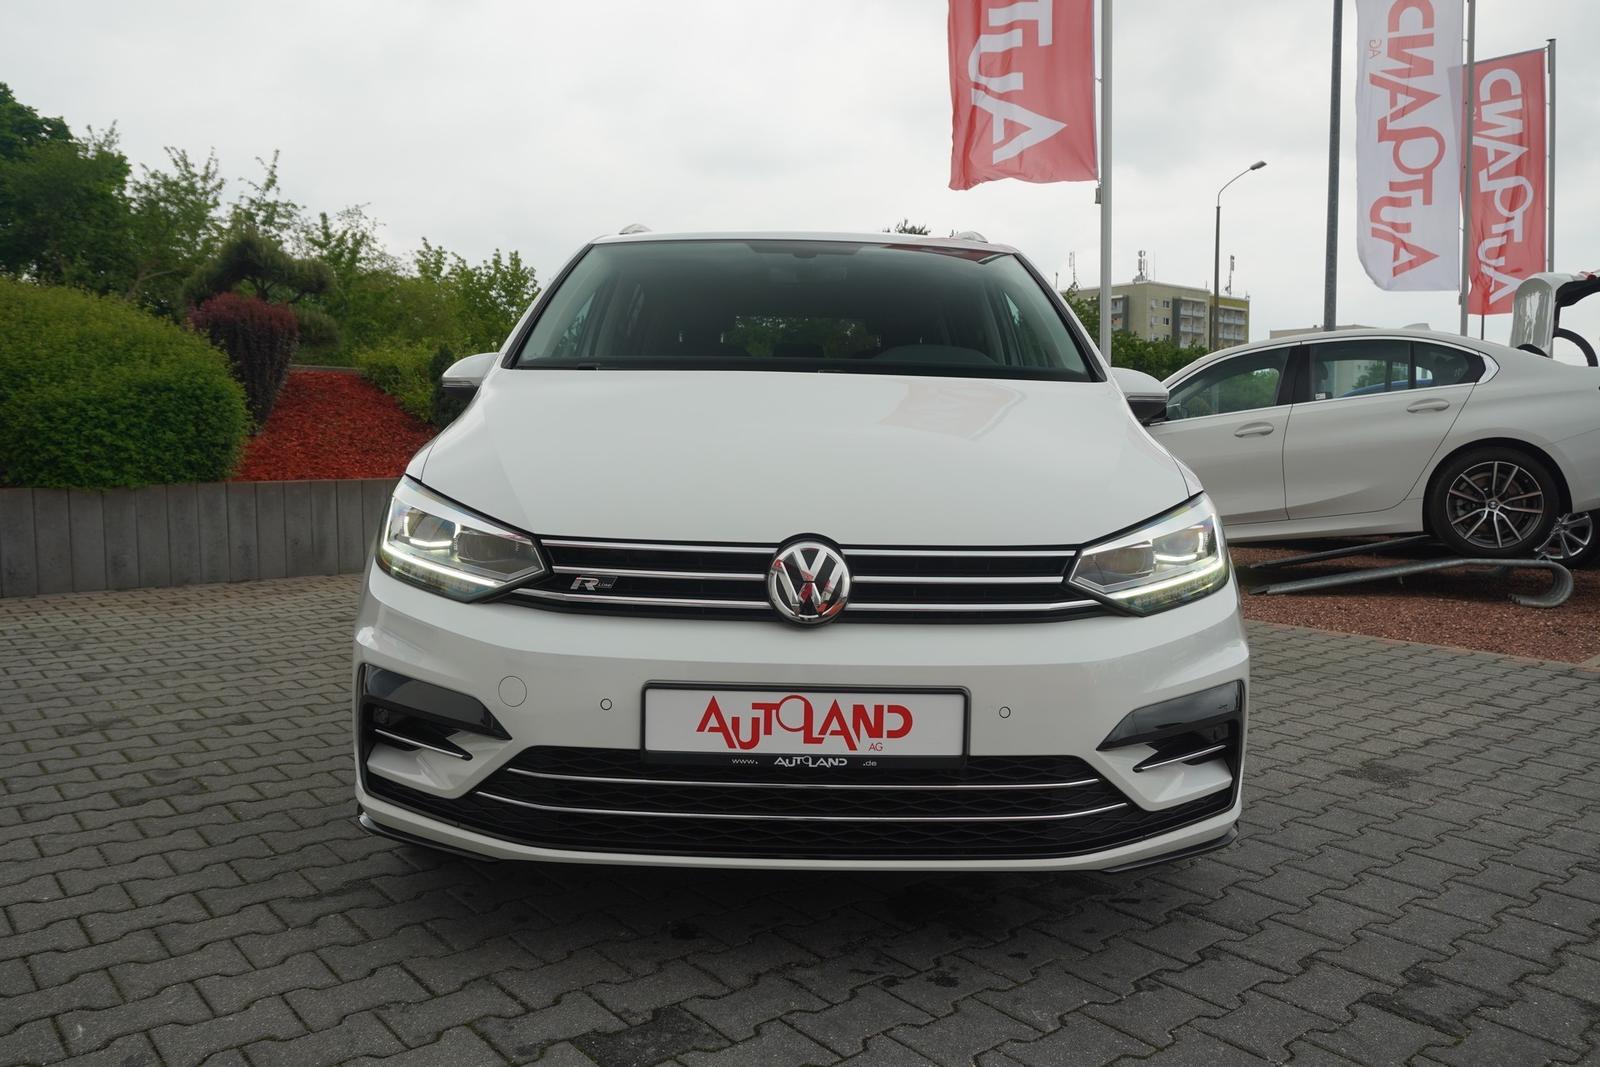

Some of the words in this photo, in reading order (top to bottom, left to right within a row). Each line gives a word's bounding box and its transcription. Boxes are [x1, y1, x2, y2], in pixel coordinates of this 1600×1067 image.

[696, 695, 913, 750] AUTOLAND
[868, 742, 883, 751] AG
[774, 755, 847, 768] AUTOLAND
